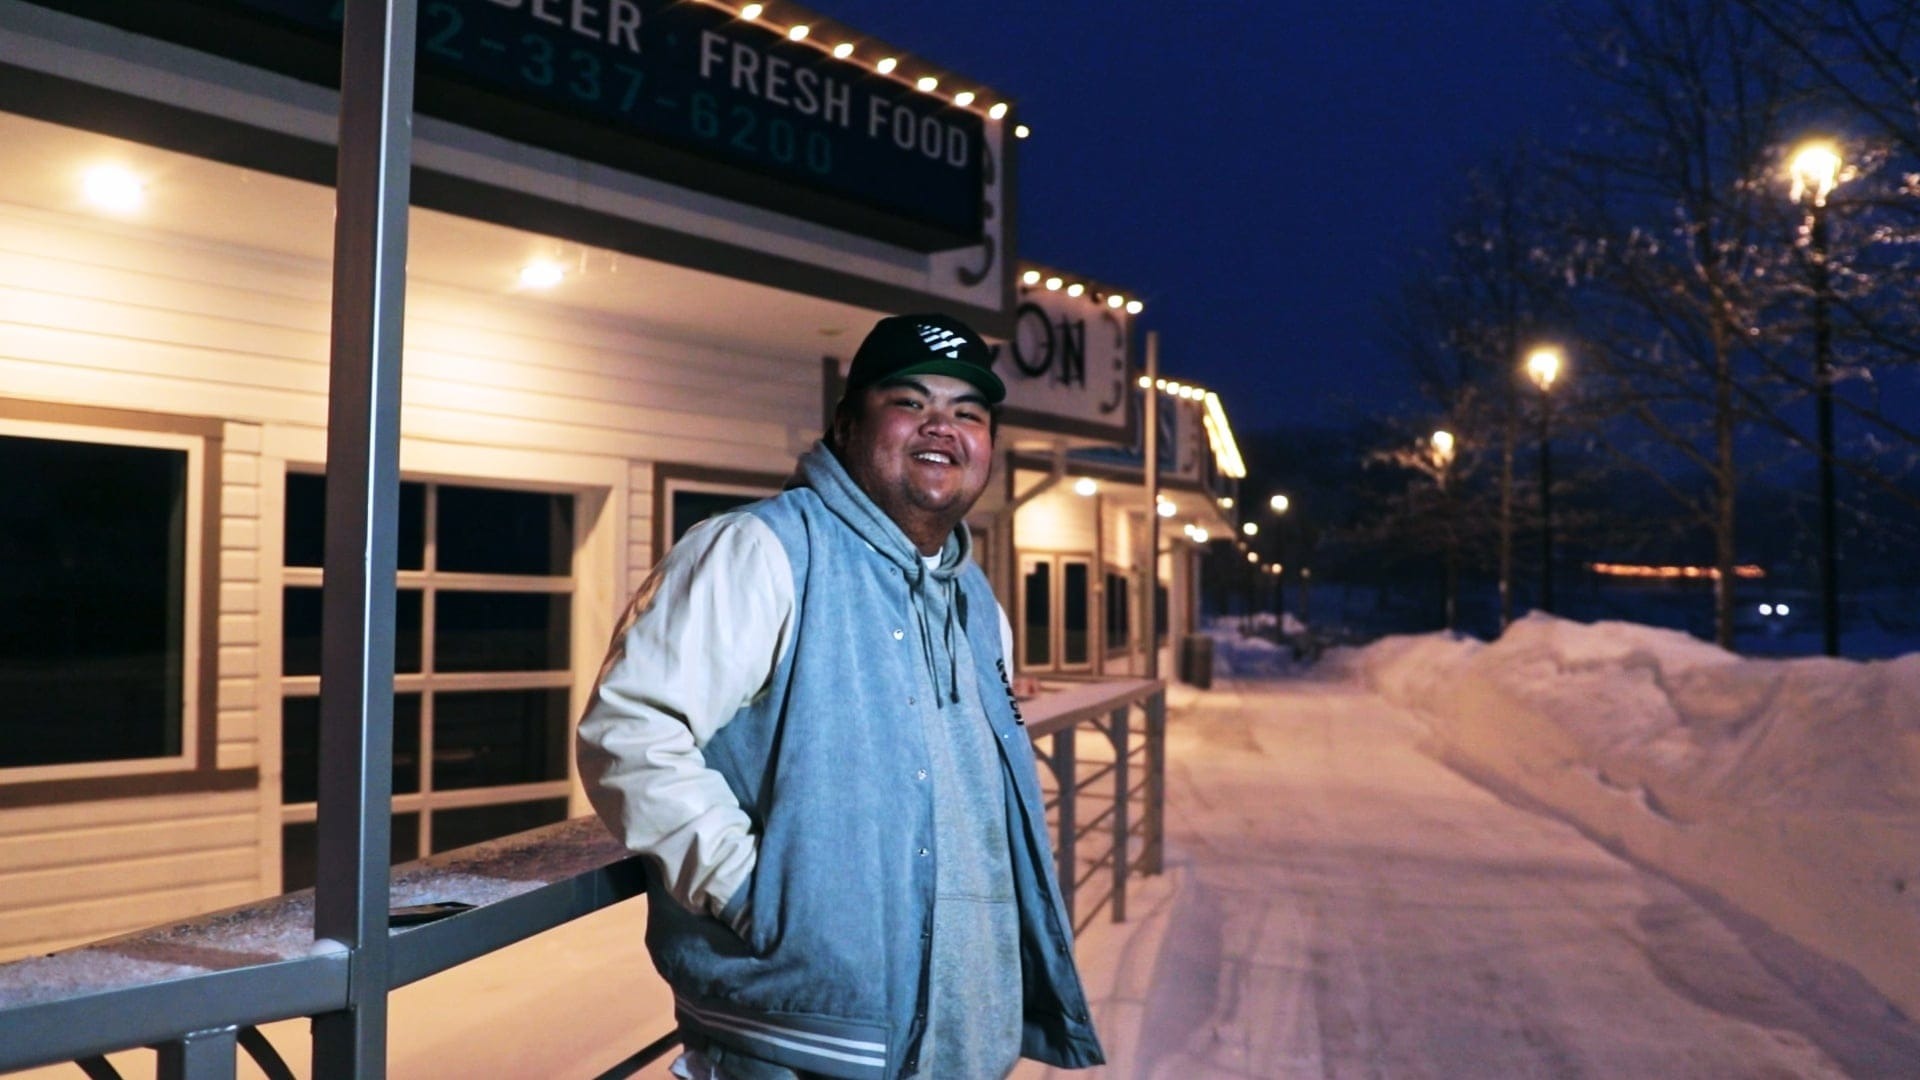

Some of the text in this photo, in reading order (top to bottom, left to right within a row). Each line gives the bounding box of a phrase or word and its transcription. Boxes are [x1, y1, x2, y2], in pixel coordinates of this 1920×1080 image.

[328, 2, 833, 176] 2-337-6200
[486, 0, 969, 170] ER FRESH FOOD
[988, 303, 1085, 389] ON
